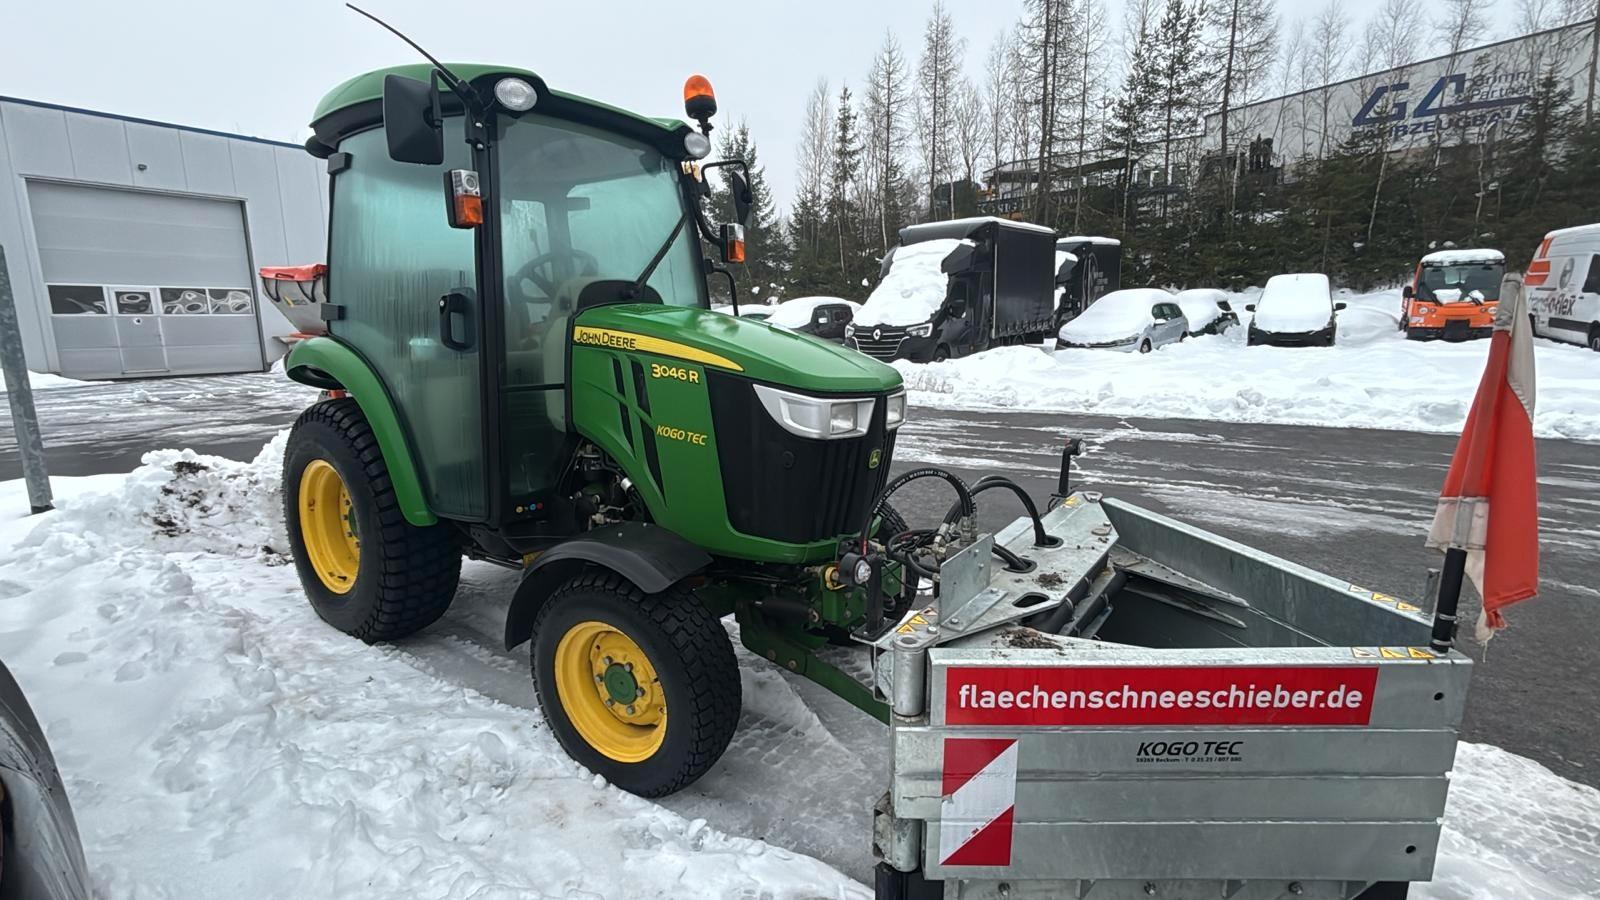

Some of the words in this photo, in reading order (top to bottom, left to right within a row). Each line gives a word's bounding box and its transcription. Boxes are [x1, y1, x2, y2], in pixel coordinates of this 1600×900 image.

[575, 329, 600, 344] JOHN
[602, 332, 637, 349] DEERE
[651, 363, 687, 381] 3046
[656, 425, 685, 441] KOGO
[686, 432, 708, 446] TEC
[959, 683, 1362, 710] flaechenschneeschieber.de
[1136, 741, 1199, 756] KOGO
[1203, 741, 1244, 756] TEC
